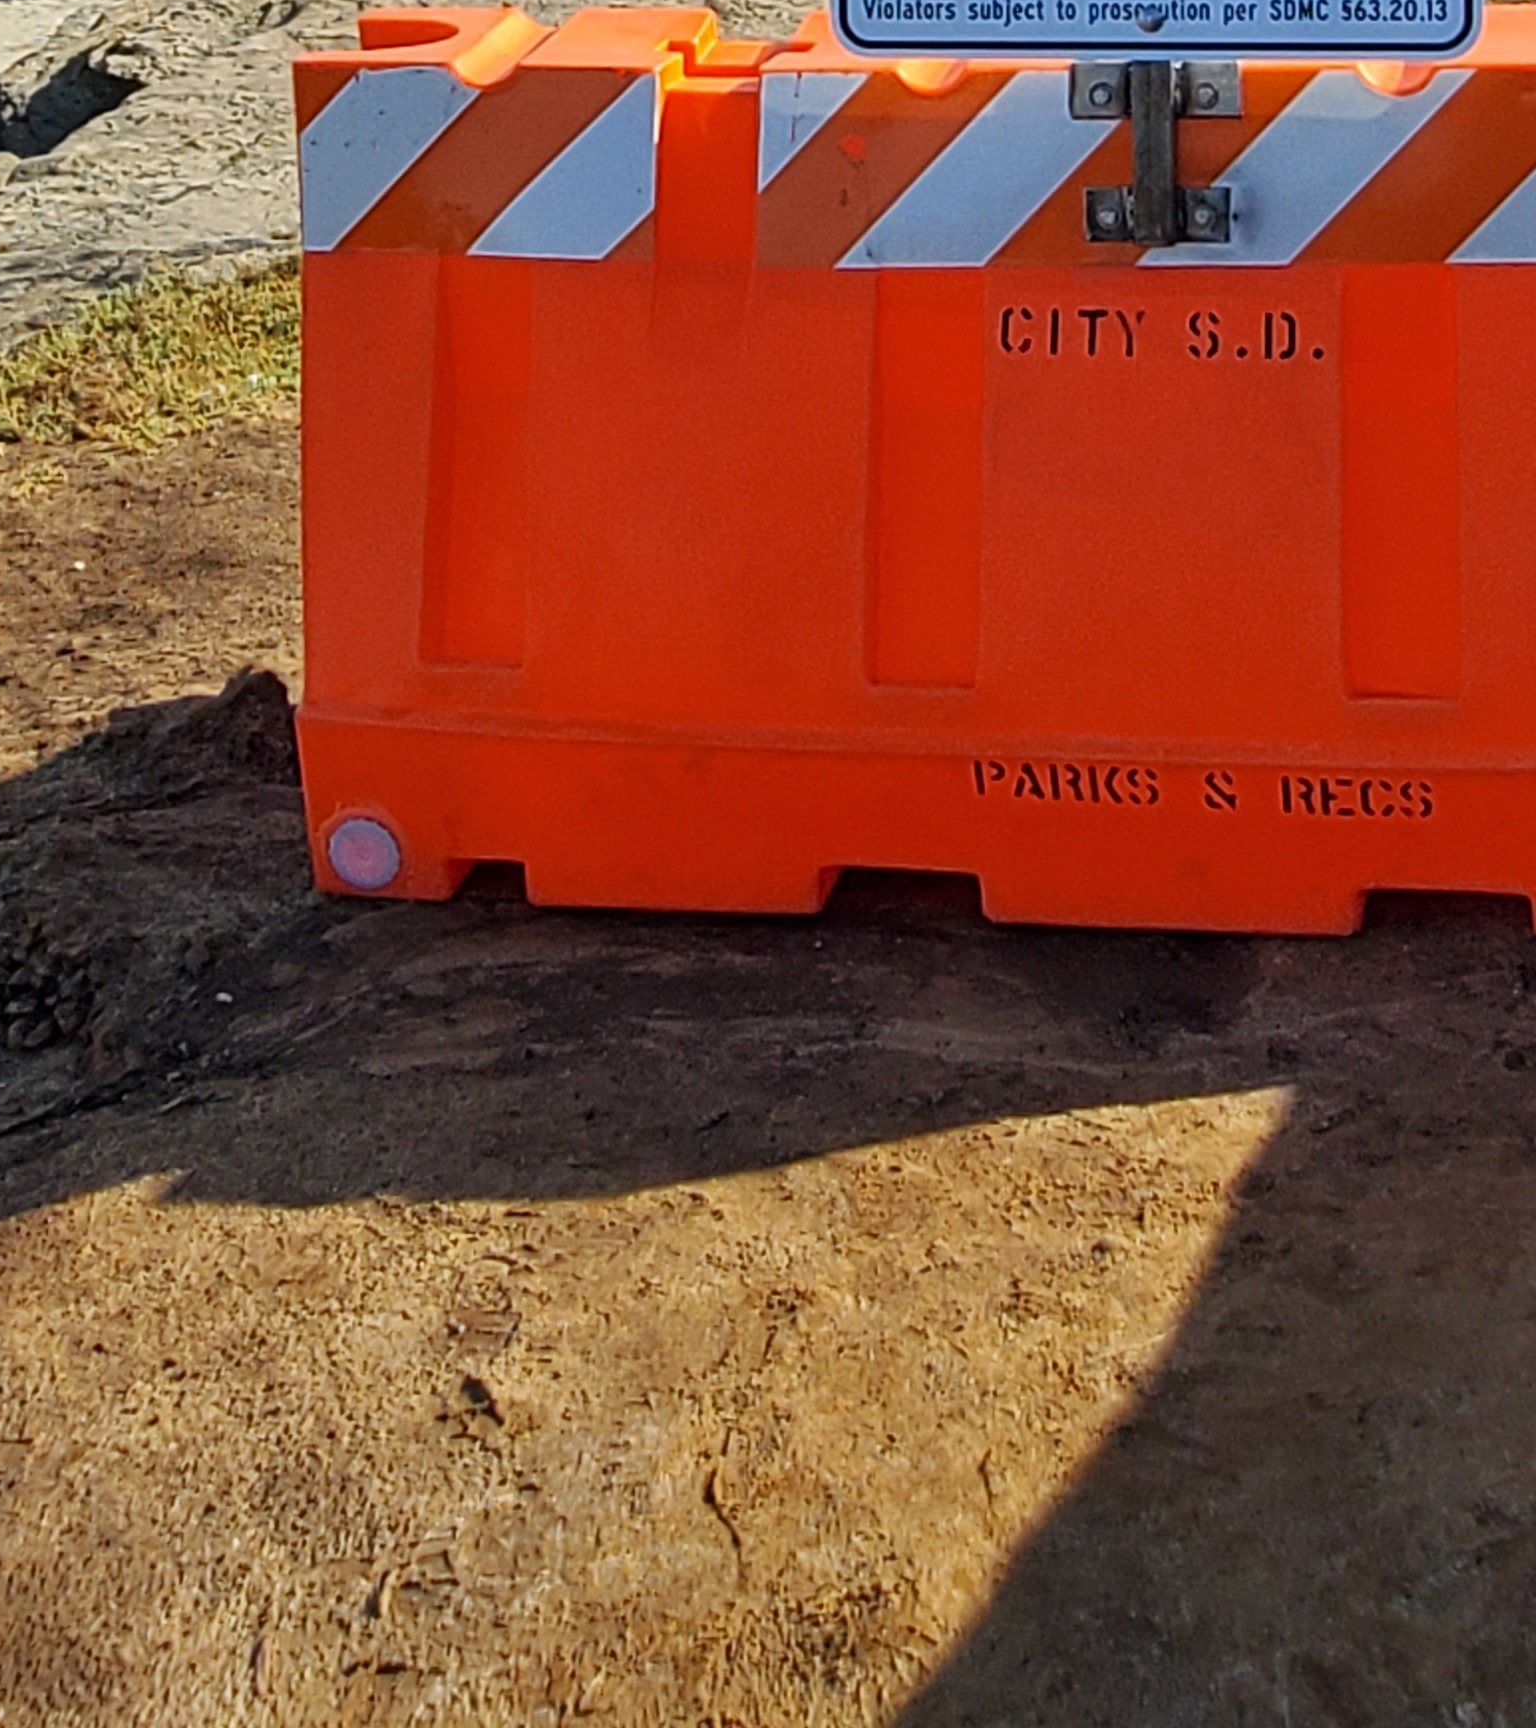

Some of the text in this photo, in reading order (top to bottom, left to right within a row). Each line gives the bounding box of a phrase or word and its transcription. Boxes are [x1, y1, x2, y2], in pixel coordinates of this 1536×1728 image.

[968, 0, 1044, 27] subject
[1056, 0, 1077, 20] to
[1223, 2, 1258, 25] per
[1000, 307, 1325, 360] CITY S.D.
[974, 760, 1432, 818] PARKS & RECS
